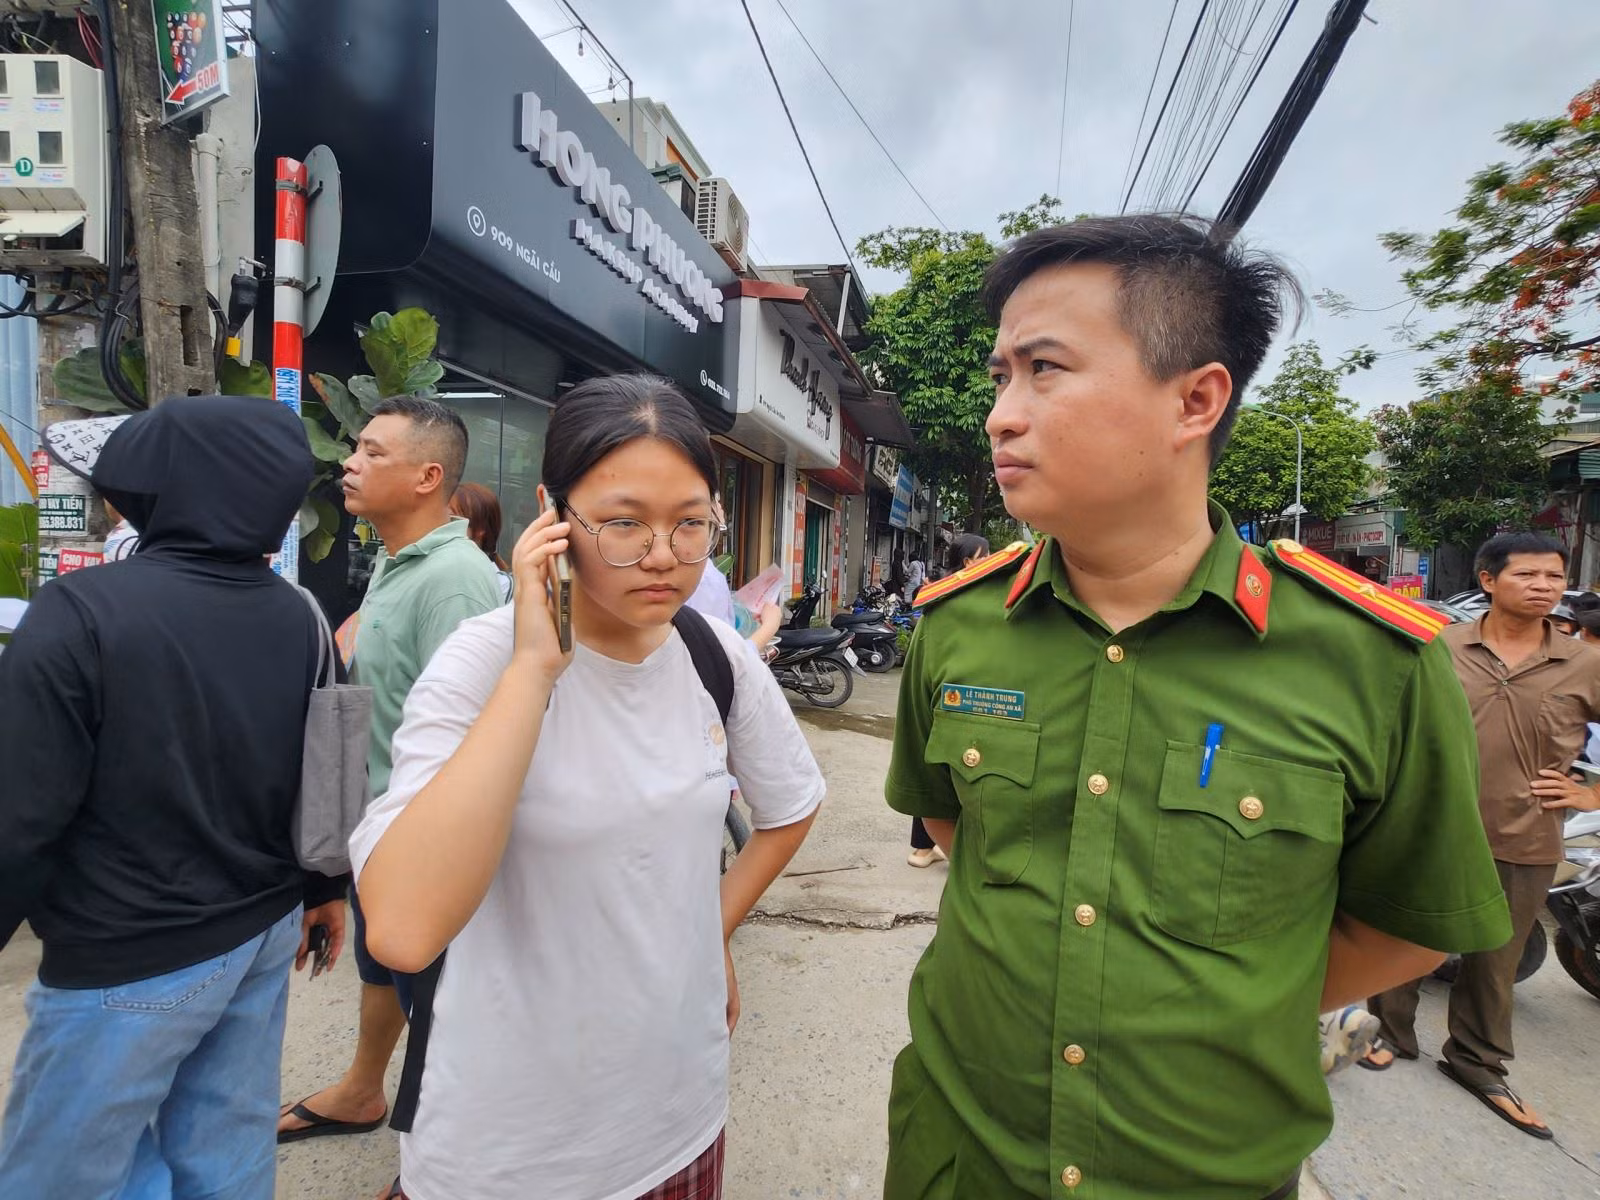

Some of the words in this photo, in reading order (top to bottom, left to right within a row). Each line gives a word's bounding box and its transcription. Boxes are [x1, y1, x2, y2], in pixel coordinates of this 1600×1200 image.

[197, 63, 219, 91] 50M
[20, 159, 31, 173] D
[521, 91, 632, 234] HONG
[490, 225, 514, 252] 909
[575, 218, 643, 284] MAKEUP
[1309, 525, 1333, 541] MIXUE
[996, 694, 1017, 703] TRUNG
